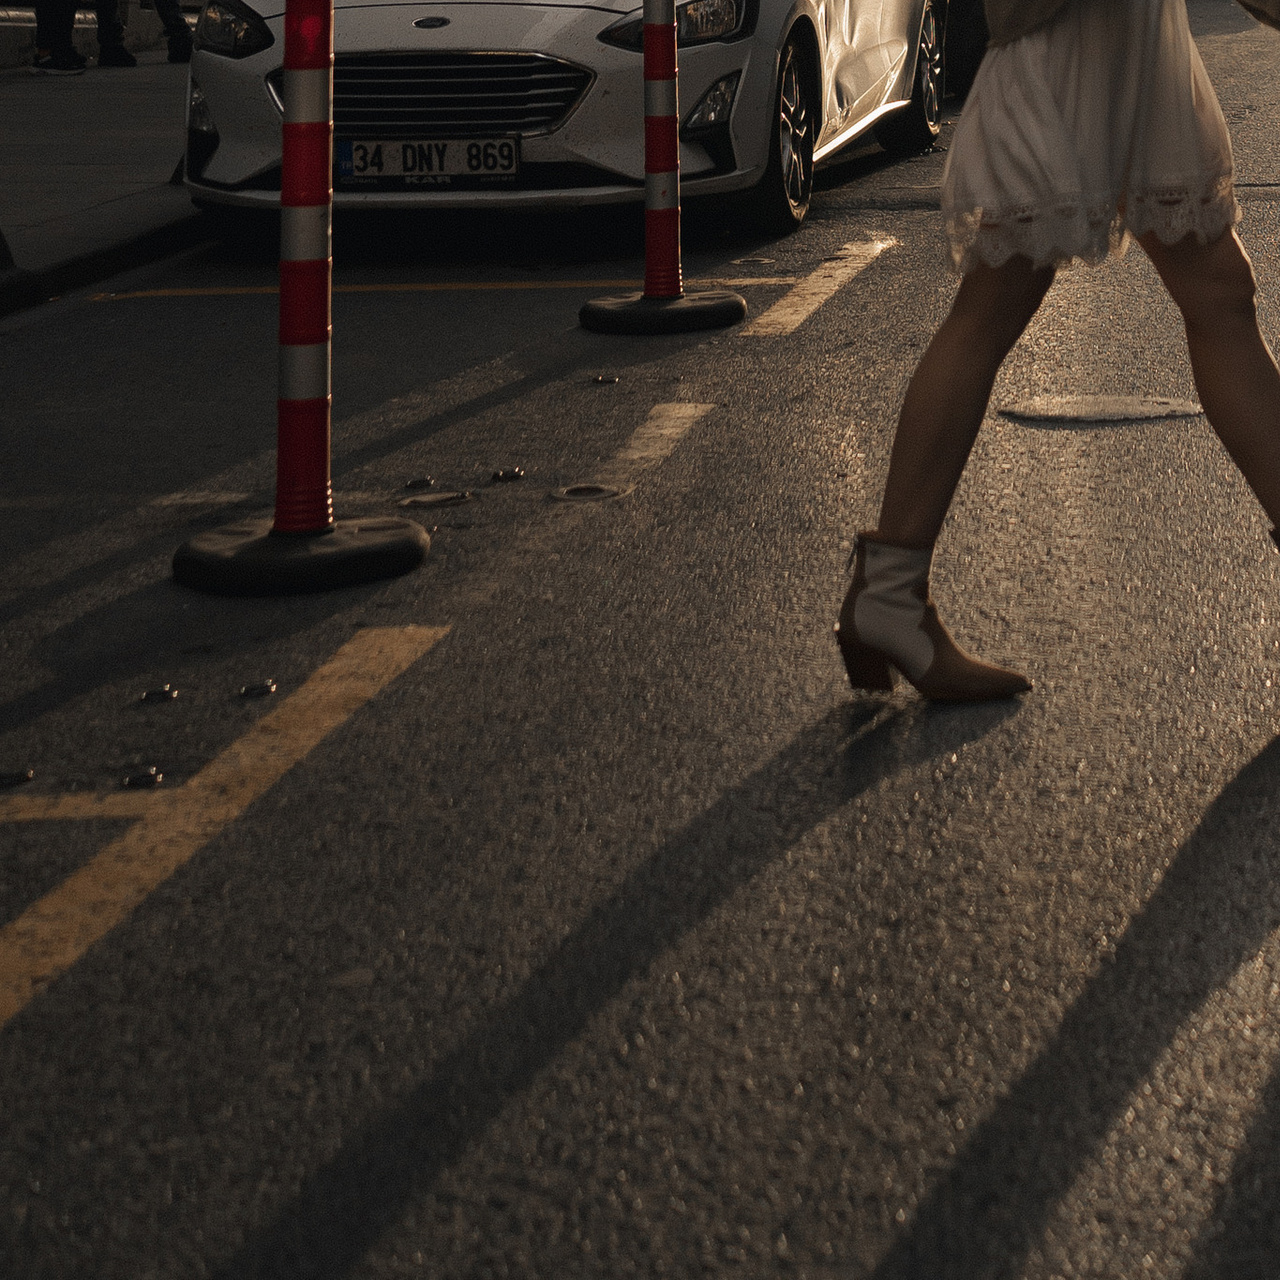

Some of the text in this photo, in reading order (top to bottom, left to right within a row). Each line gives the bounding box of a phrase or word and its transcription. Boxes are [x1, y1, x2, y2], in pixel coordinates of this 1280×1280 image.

[354, 142, 514, 173] 34 DNY 869
